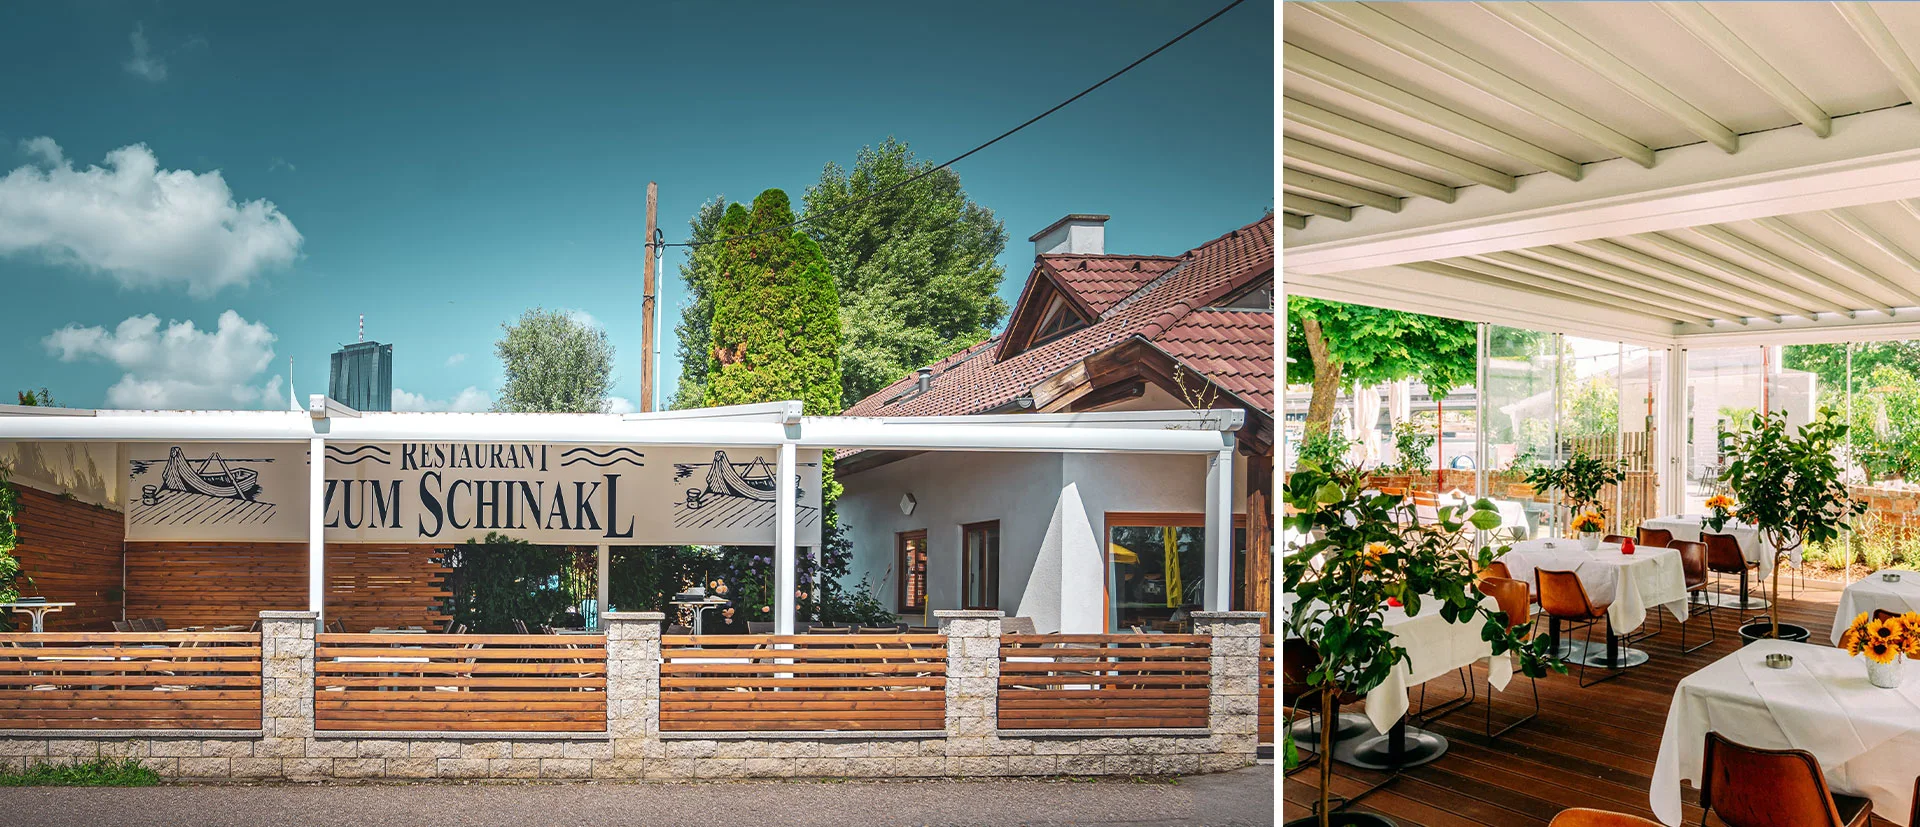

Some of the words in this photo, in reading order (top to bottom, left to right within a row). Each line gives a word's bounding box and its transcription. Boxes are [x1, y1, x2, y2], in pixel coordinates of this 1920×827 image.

[400, 443, 553, 472] RESTAURANT
[324, 479, 404, 529] ZUM
[418, 471, 635, 538] SCHINAKL
